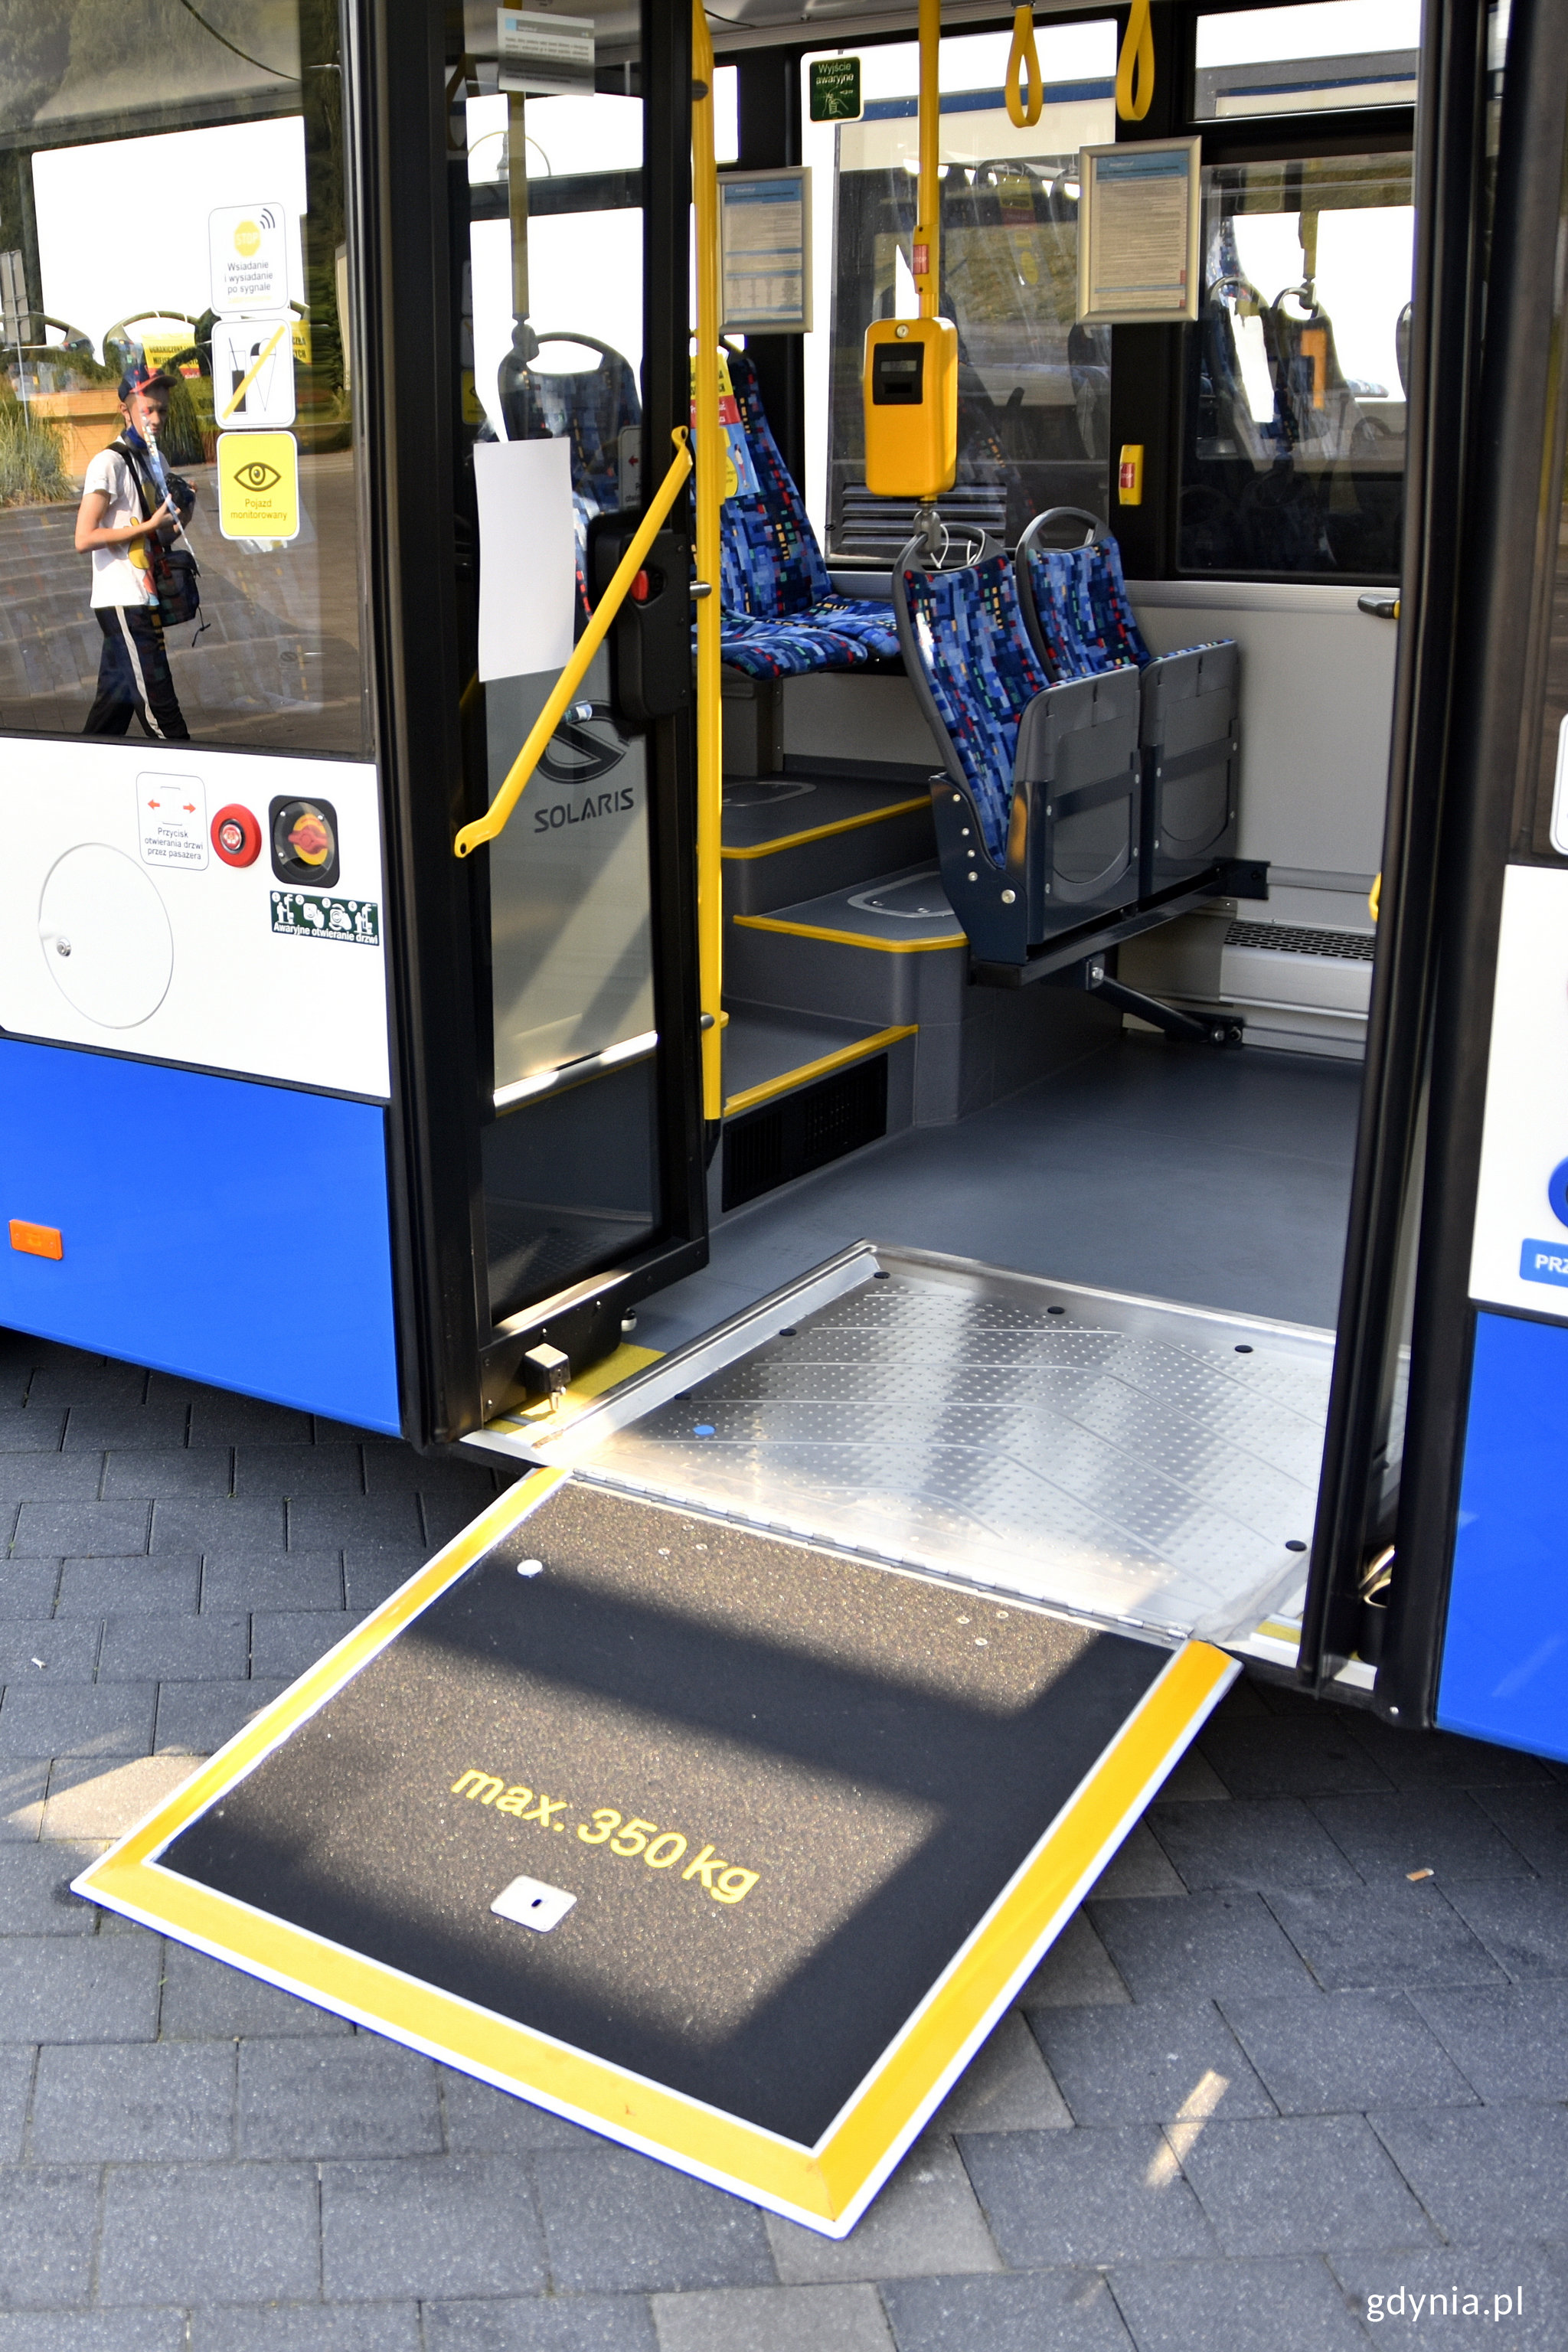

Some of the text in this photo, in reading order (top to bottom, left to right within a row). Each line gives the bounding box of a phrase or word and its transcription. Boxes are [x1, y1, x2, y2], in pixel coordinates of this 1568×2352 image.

[818, 61, 851, 75] Wyjście
[816, 72, 854, 84] awaryjne
[236, 232, 259, 245] STOP
[228, 260, 269, 271] Wsiadanie
[229, 270, 273, 284] wysiadanie
[227, 281, 271, 296] po sygnale
[245, 498, 272, 510] Pojazd
[230, 511, 287, 521] monitorowany
[534, 788, 634, 833] SOLARIS
[158, 827, 188, 838] Przycisk
[144, 837, 204, 850] otwierania drzwi
[148, 848, 201, 860] przez pasażera
[273, 921, 378, 945] Awaryjne otwieranie drzwi
[451, 1769, 761, 1905] max. 350 kg
